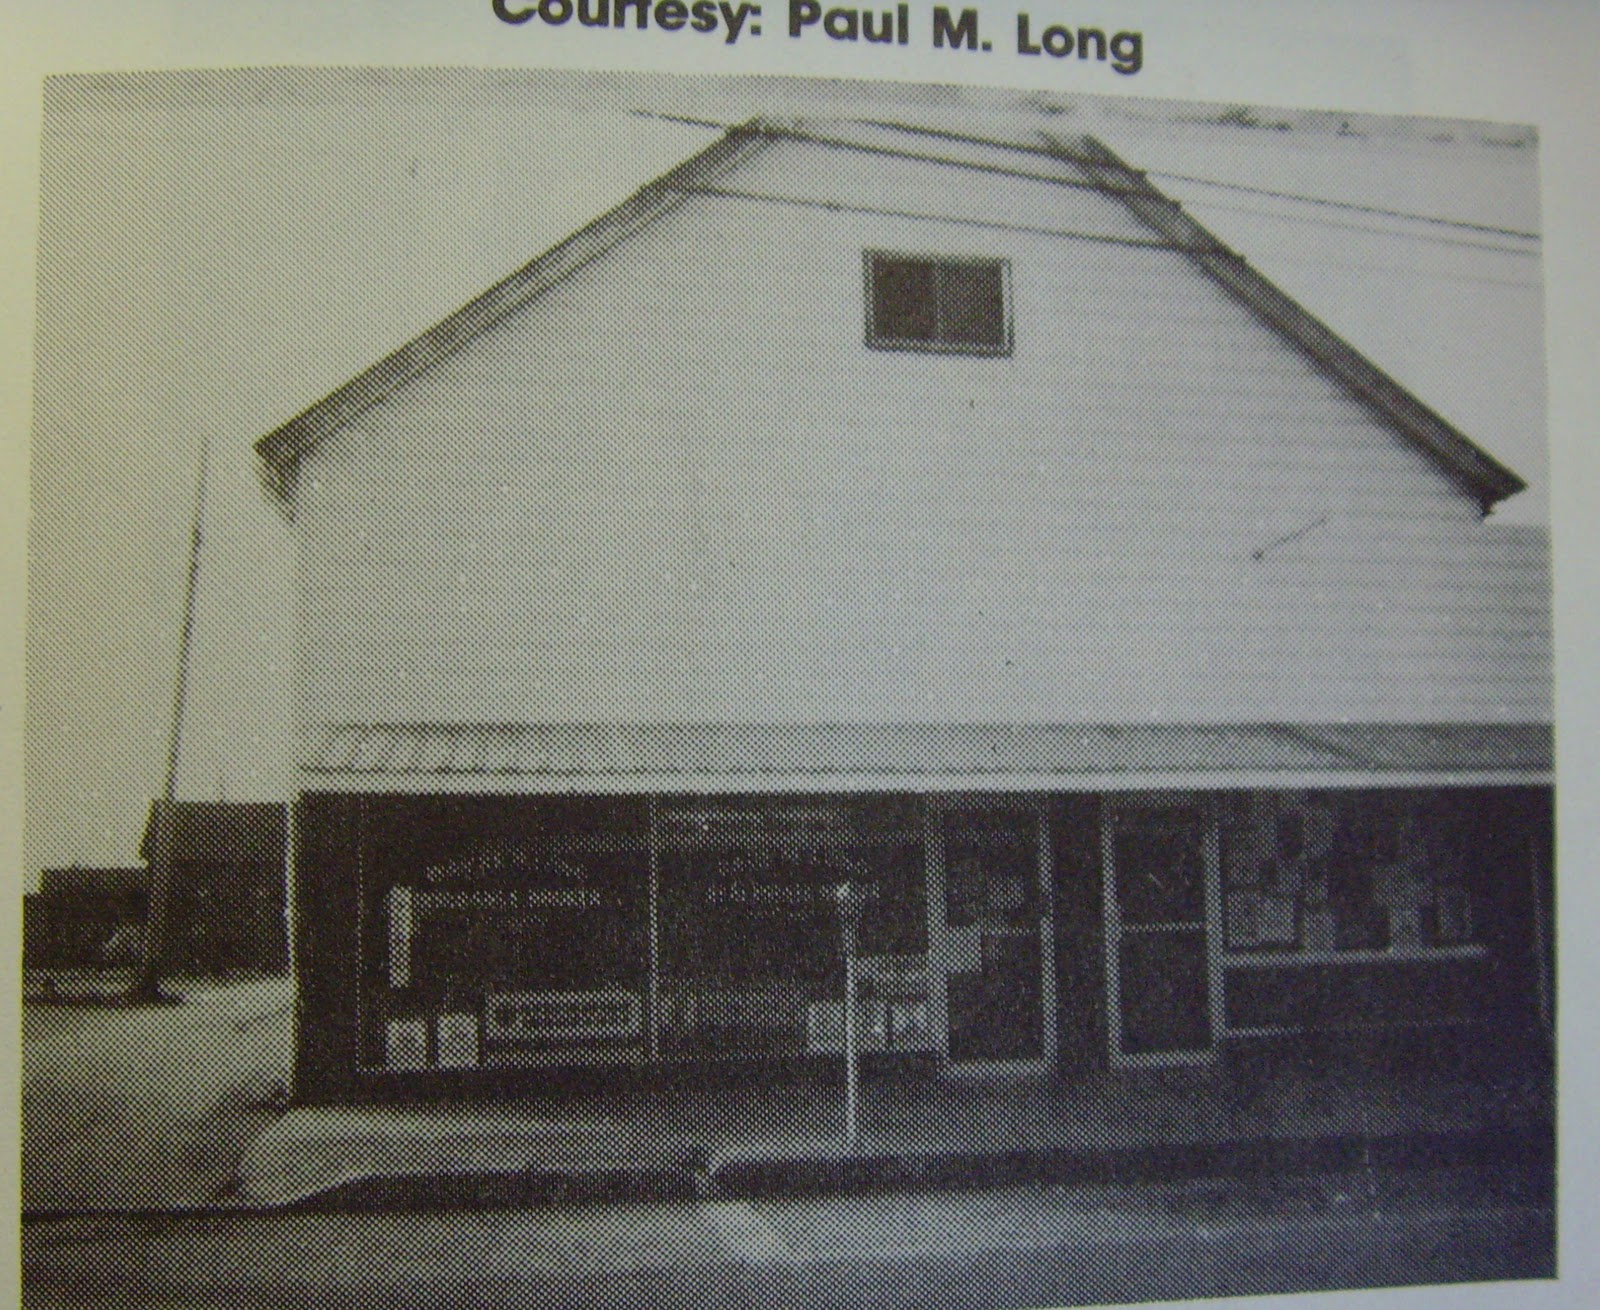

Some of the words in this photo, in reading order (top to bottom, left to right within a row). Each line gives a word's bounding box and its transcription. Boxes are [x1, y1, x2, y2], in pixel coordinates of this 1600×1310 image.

[493, 0, 762, 44] Courtesy:
[789, 0, 909, 45] Paul
[934, 6, 992, 51] M.
[1018, 14, 1143, 75] Long
